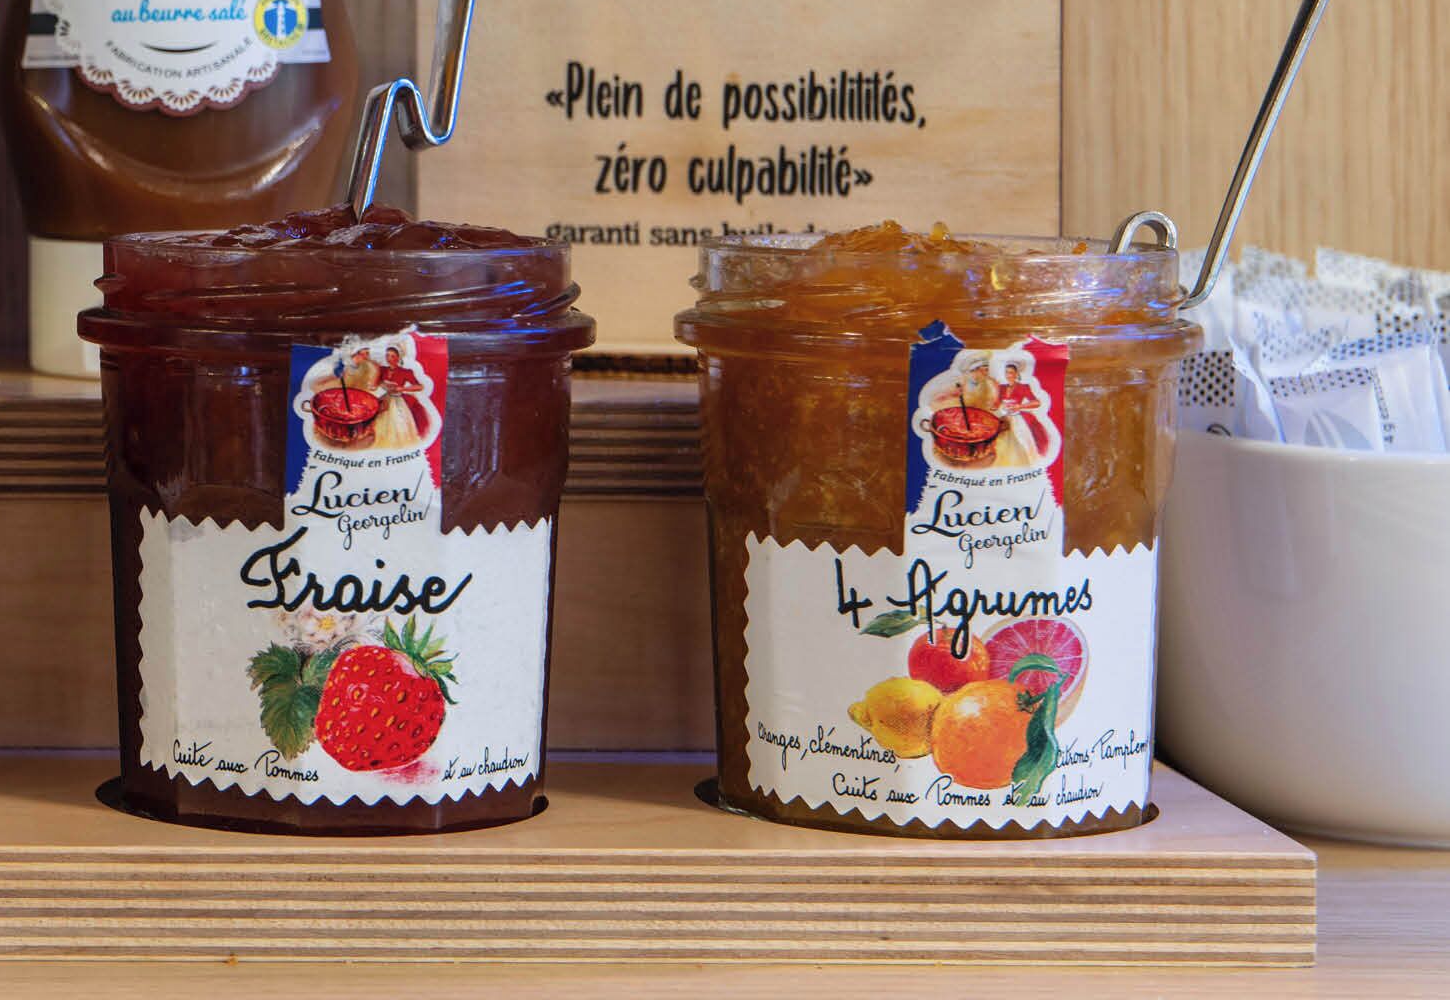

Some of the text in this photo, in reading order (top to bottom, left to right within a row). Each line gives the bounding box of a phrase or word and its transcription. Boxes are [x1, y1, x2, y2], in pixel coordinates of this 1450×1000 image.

[111, 4, 136, 23] au
[546, 61, 643, 120] «Plein
[664, 69, 702, 120] de
[595, 143, 874, 204] zéro culpabilité»
[313, 449, 421, 468] Fabriqué en France
[933, 468, 1043, 487] Fabriqué en France
[291, 470, 424, 518] Lucien
[911, 488, 1046, 538] Lucien
[337, 492, 434, 551] Georgelin
[958, 512, 1055, 570] Georgelin
[240, 527, 473, 615] Fraise
[834, 558, 1093, 660] 4 Agrumes
[172, 738, 214, 767] Cuite
[215, 759, 249, 774] aux
[254, 750, 319, 782] Pommes
[442, 756, 460, 781] et
[478, 746, 530, 775] chaudron
[809, 725, 901, 773] clémentines,
[832, 772, 1105, 808] Cuits aux Pommes et au chaudron
